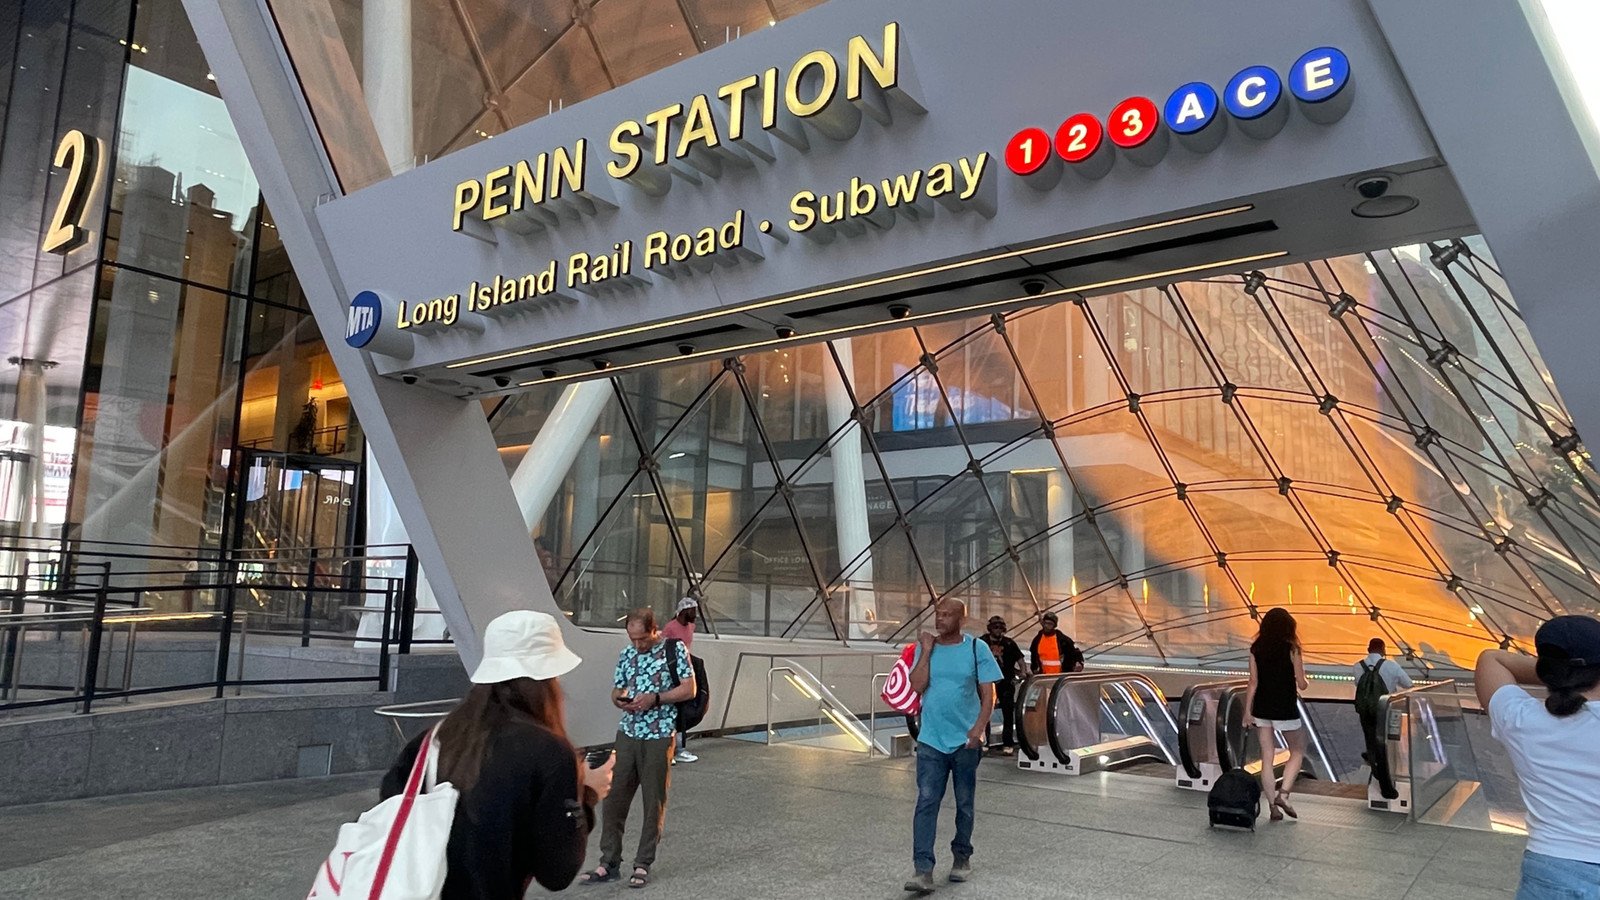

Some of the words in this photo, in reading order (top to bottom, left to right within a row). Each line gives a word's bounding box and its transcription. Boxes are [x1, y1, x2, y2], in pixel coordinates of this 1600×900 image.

[42, 129, 96, 254] 2
[396, 293, 460, 329] Long
[468, 260, 558, 313] Island
[567, 240, 632, 288] Rail
[643, 208, 745, 269] Road
[788, 152, 990, 232] Subway
[1067, 124, 1088, 152] 2
[1121, 108, 1143, 137] 3
[1176, 92, 1205, 124] A
[1237, 76, 1266, 107] C
[1304, 56, 1334, 92] E
[453, 138, 588, 232] PENN
[606, 21, 900, 180] STATION
[345, 305, 374, 339] MTA
